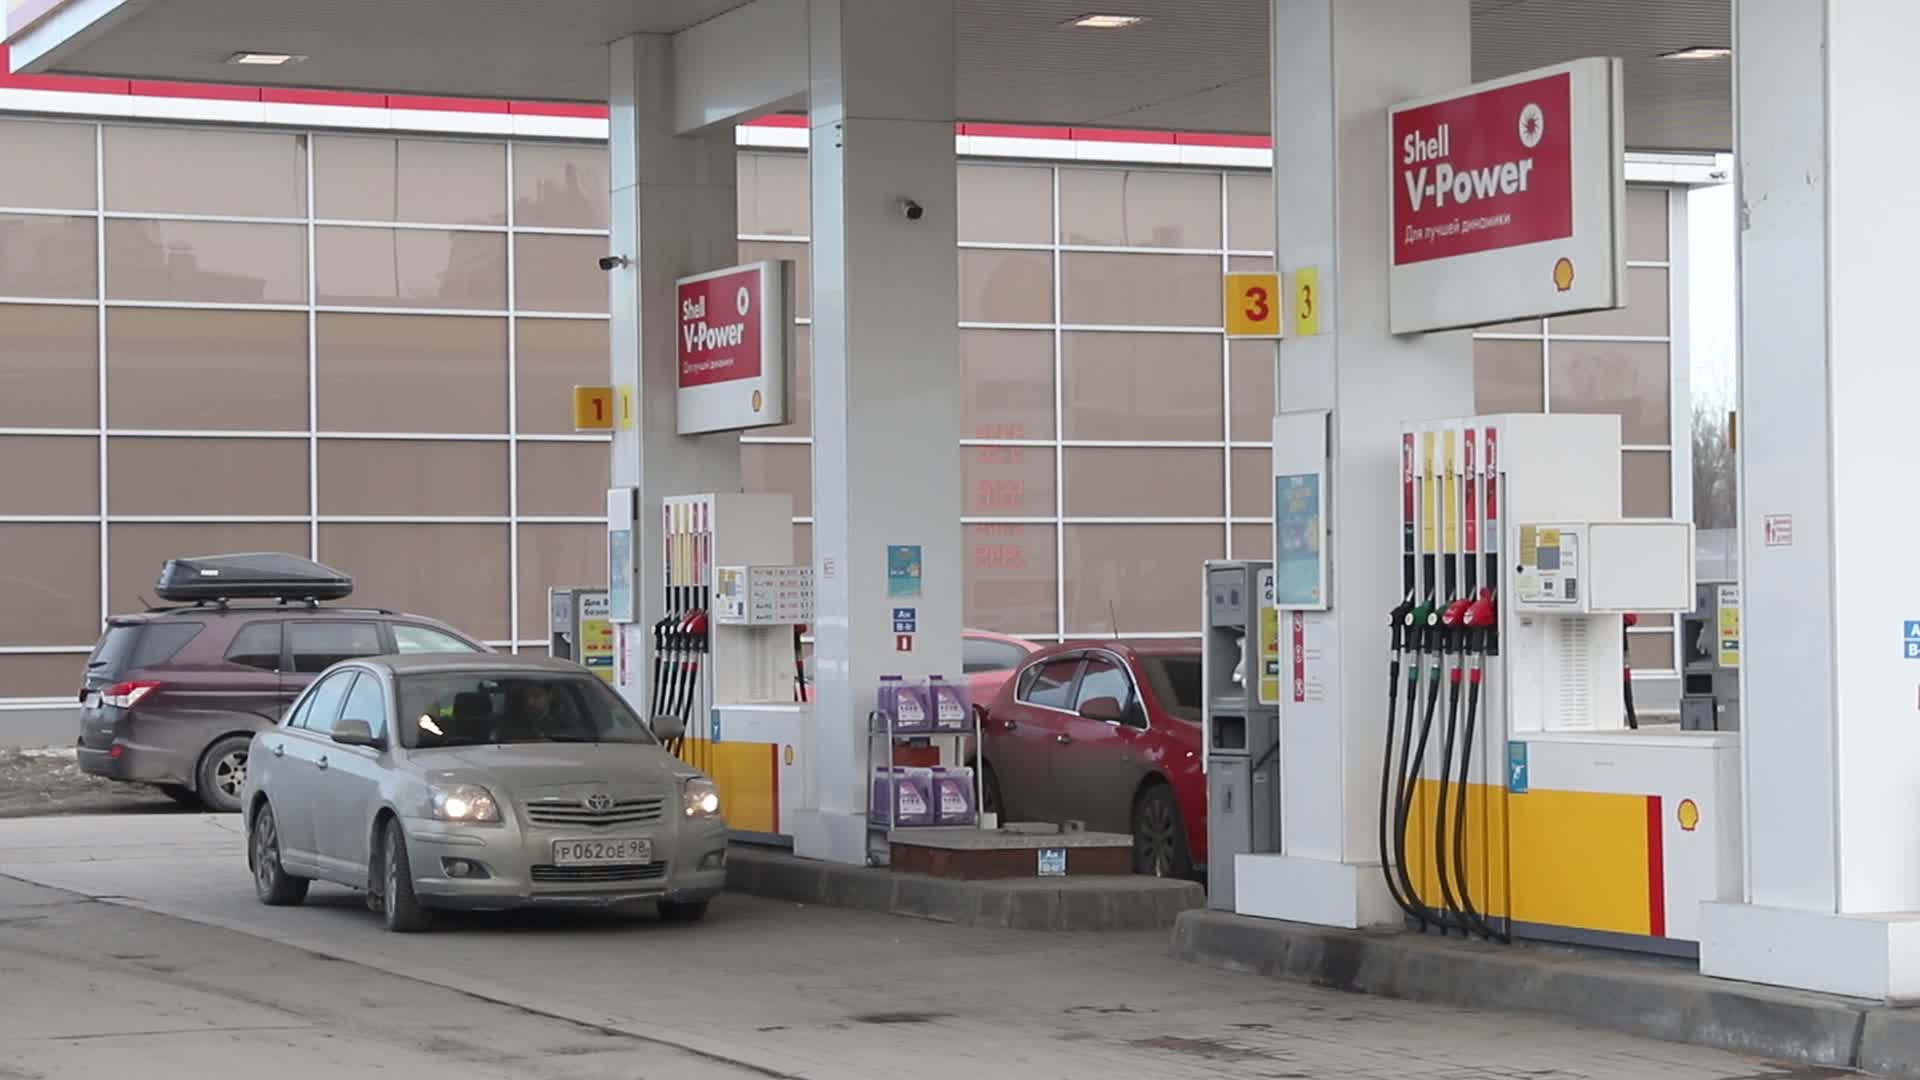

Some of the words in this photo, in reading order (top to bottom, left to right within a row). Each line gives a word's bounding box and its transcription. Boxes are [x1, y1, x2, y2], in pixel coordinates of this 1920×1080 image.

[1403, 124, 1449, 165] Shell
[1404, 158, 1533, 211] V-Power
[1404, 225, 1423, 245] Для
[1424, 218, 1460, 242] лучшей
[683, 295, 705, 321] Shell
[1244, 286, 1269, 322] 3
[1301, 284, 1312, 319] 3
[683, 321, 744, 353] V-Power
[592, 398, 602, 421] 1
